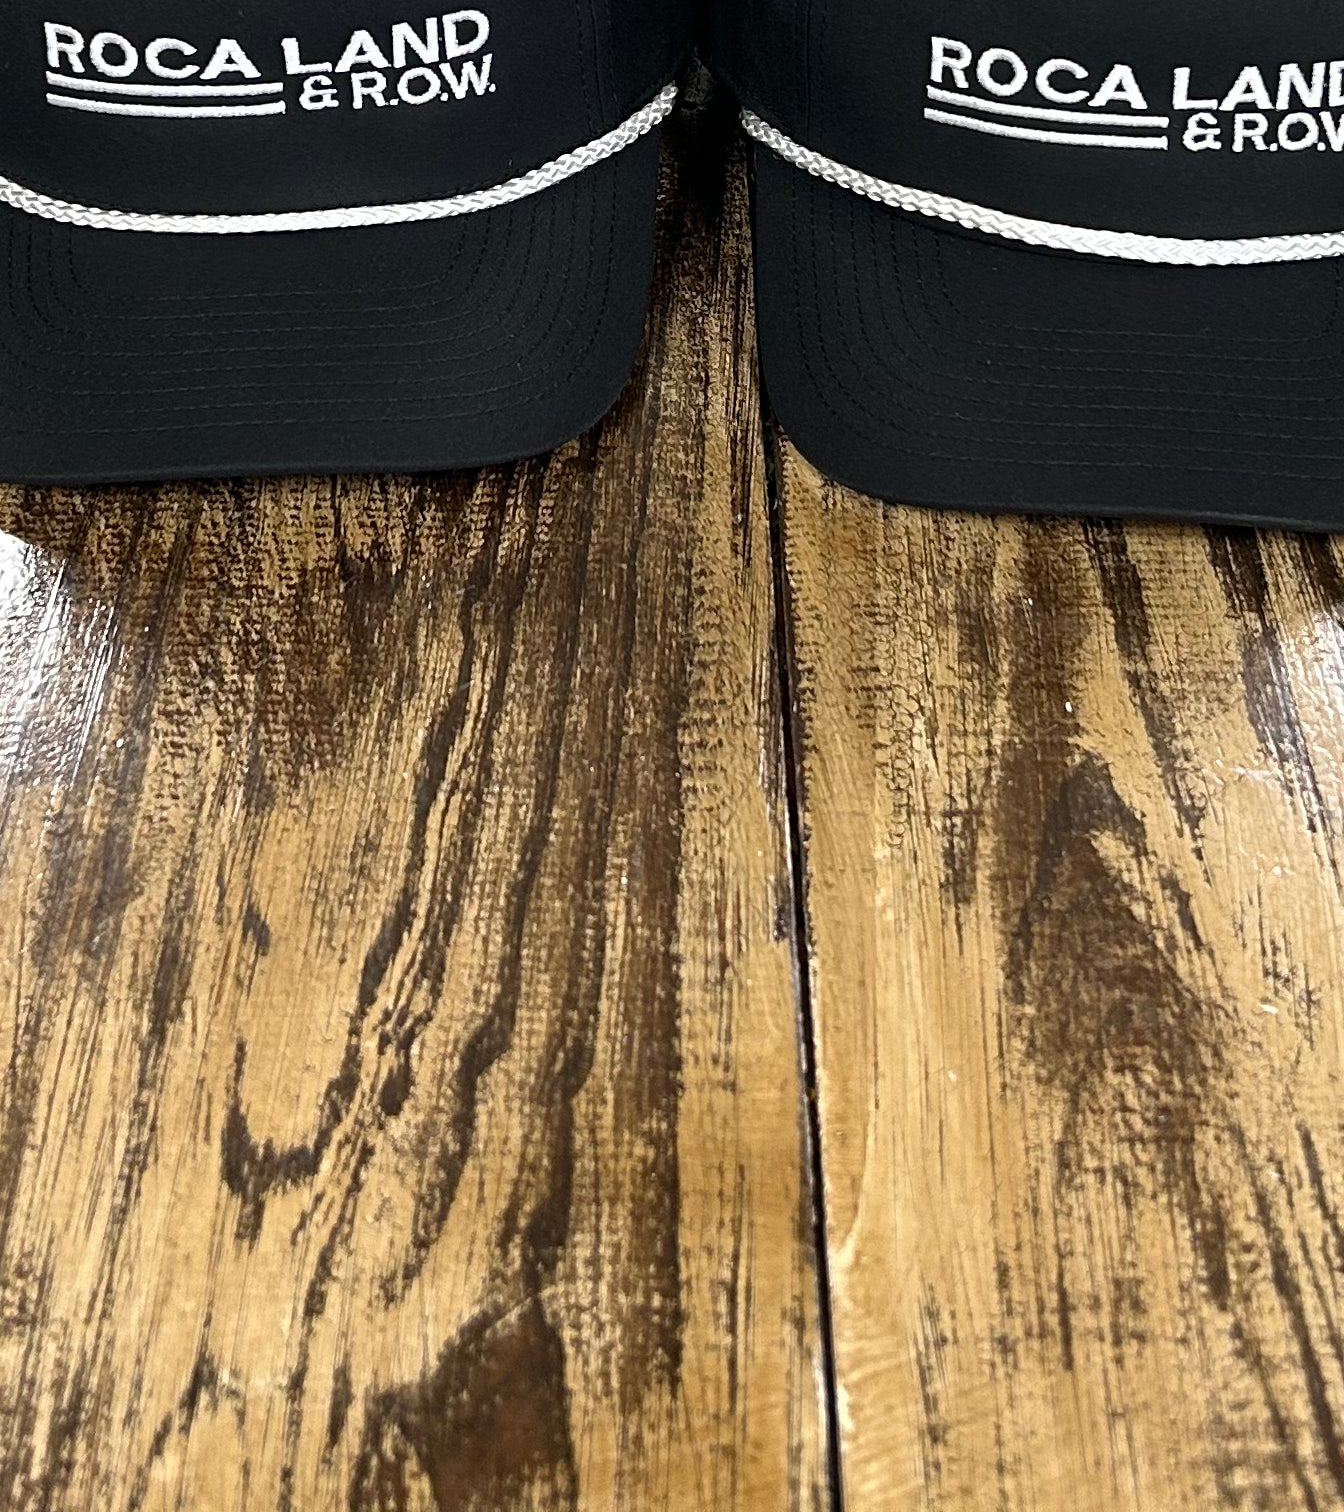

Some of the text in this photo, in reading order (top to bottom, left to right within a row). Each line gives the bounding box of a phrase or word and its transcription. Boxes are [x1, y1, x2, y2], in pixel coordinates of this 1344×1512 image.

[44, 9, 490, 80] ROCA LAND
[930, 36, 1149, 110] ROCA
[299, 53, 497, 111] & R.O.W.
[1182, 111, 1222, 152] &
